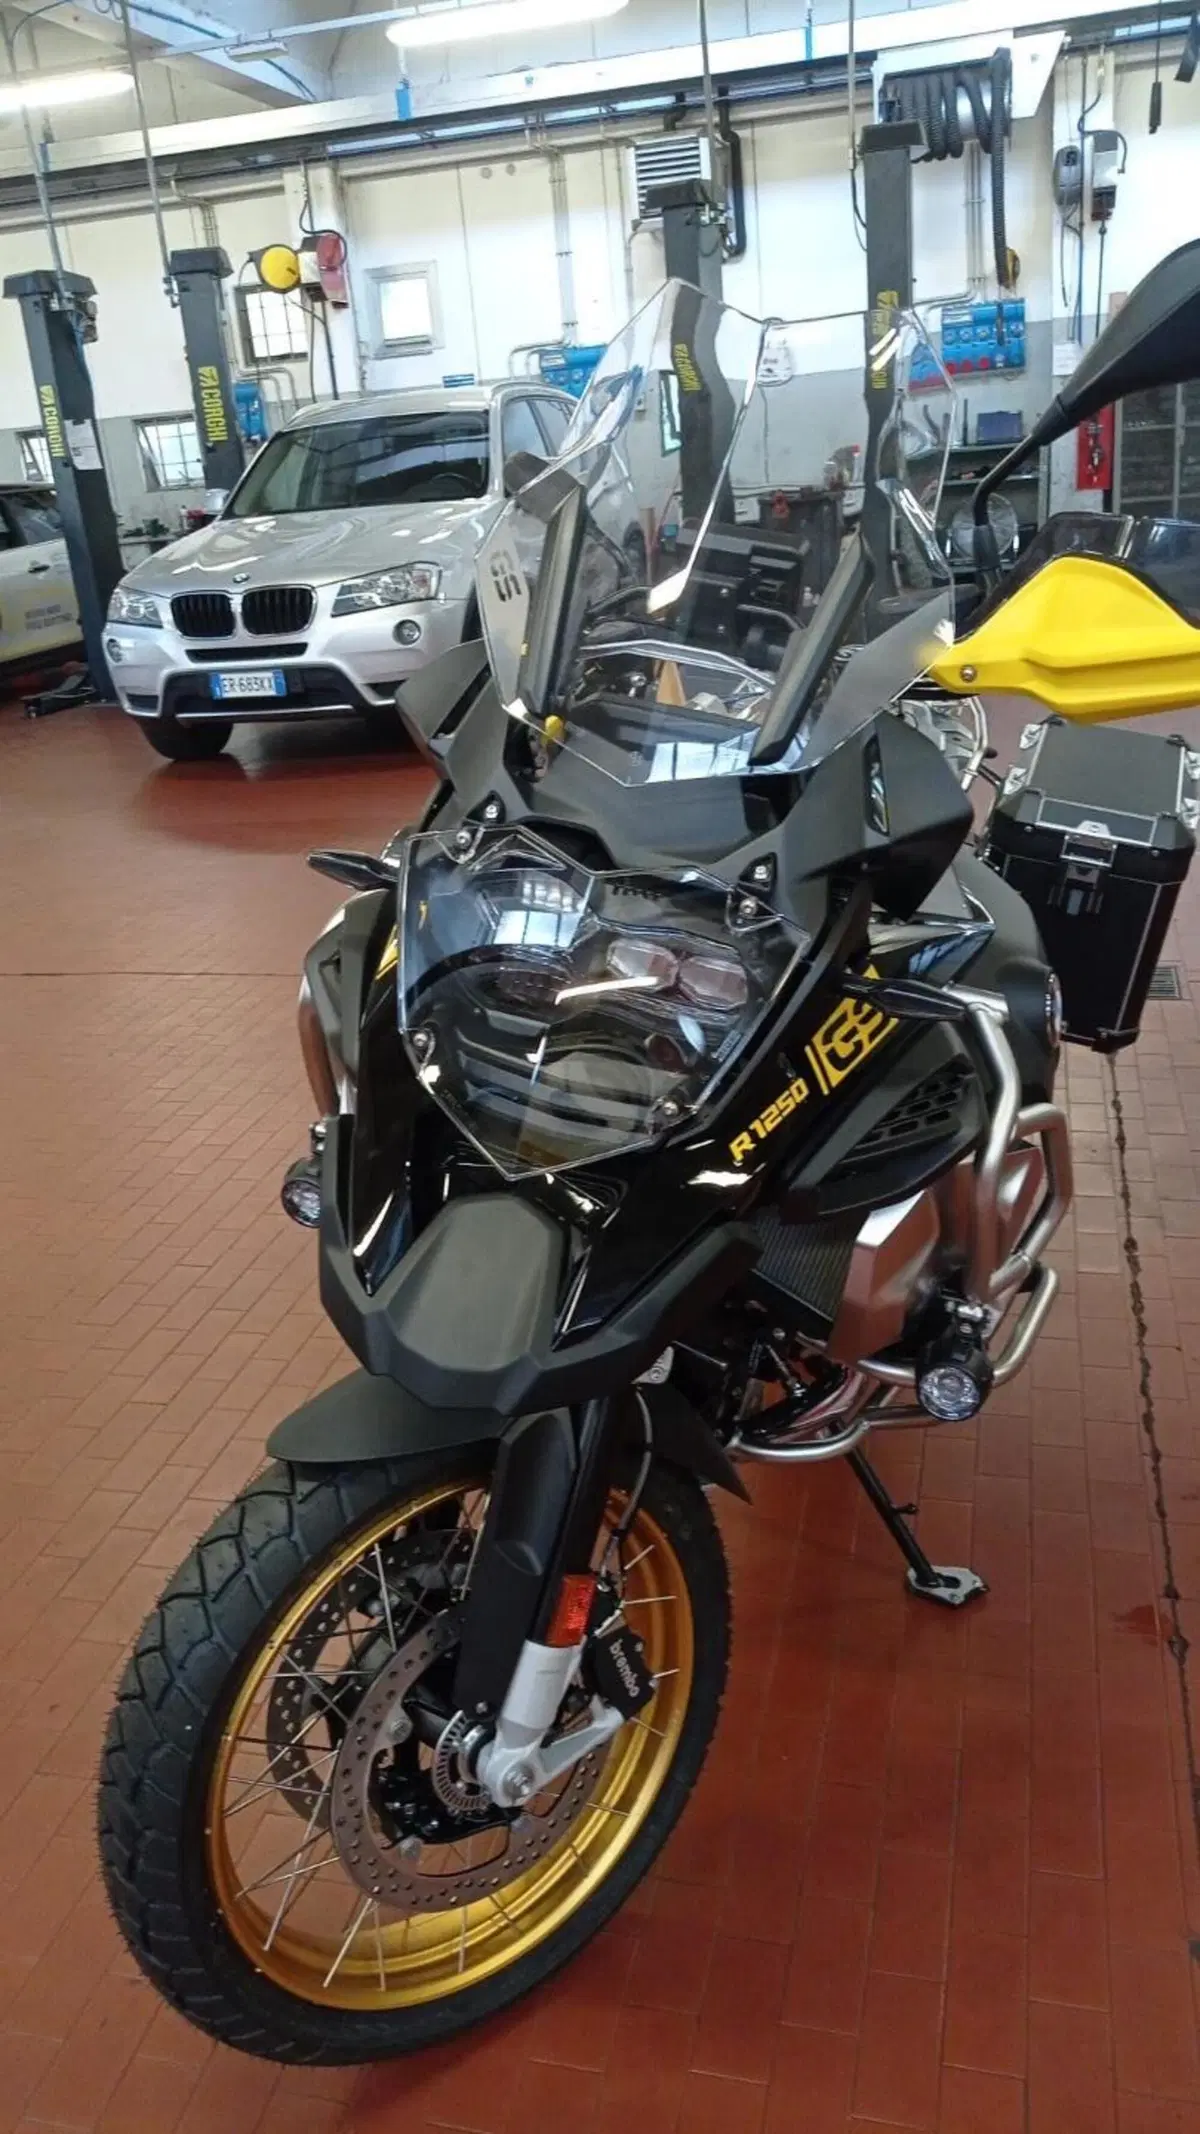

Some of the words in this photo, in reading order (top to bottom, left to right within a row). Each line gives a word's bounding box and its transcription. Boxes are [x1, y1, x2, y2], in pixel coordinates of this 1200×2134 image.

[43, 406, 66, 458] CORGHI
[201, 388, 228, 441] CORGHI
[728, 1131, 757, 1162] R
[749, 1077, 810, 1139] 1250
[609, 1638, 641, 1698] brembo
